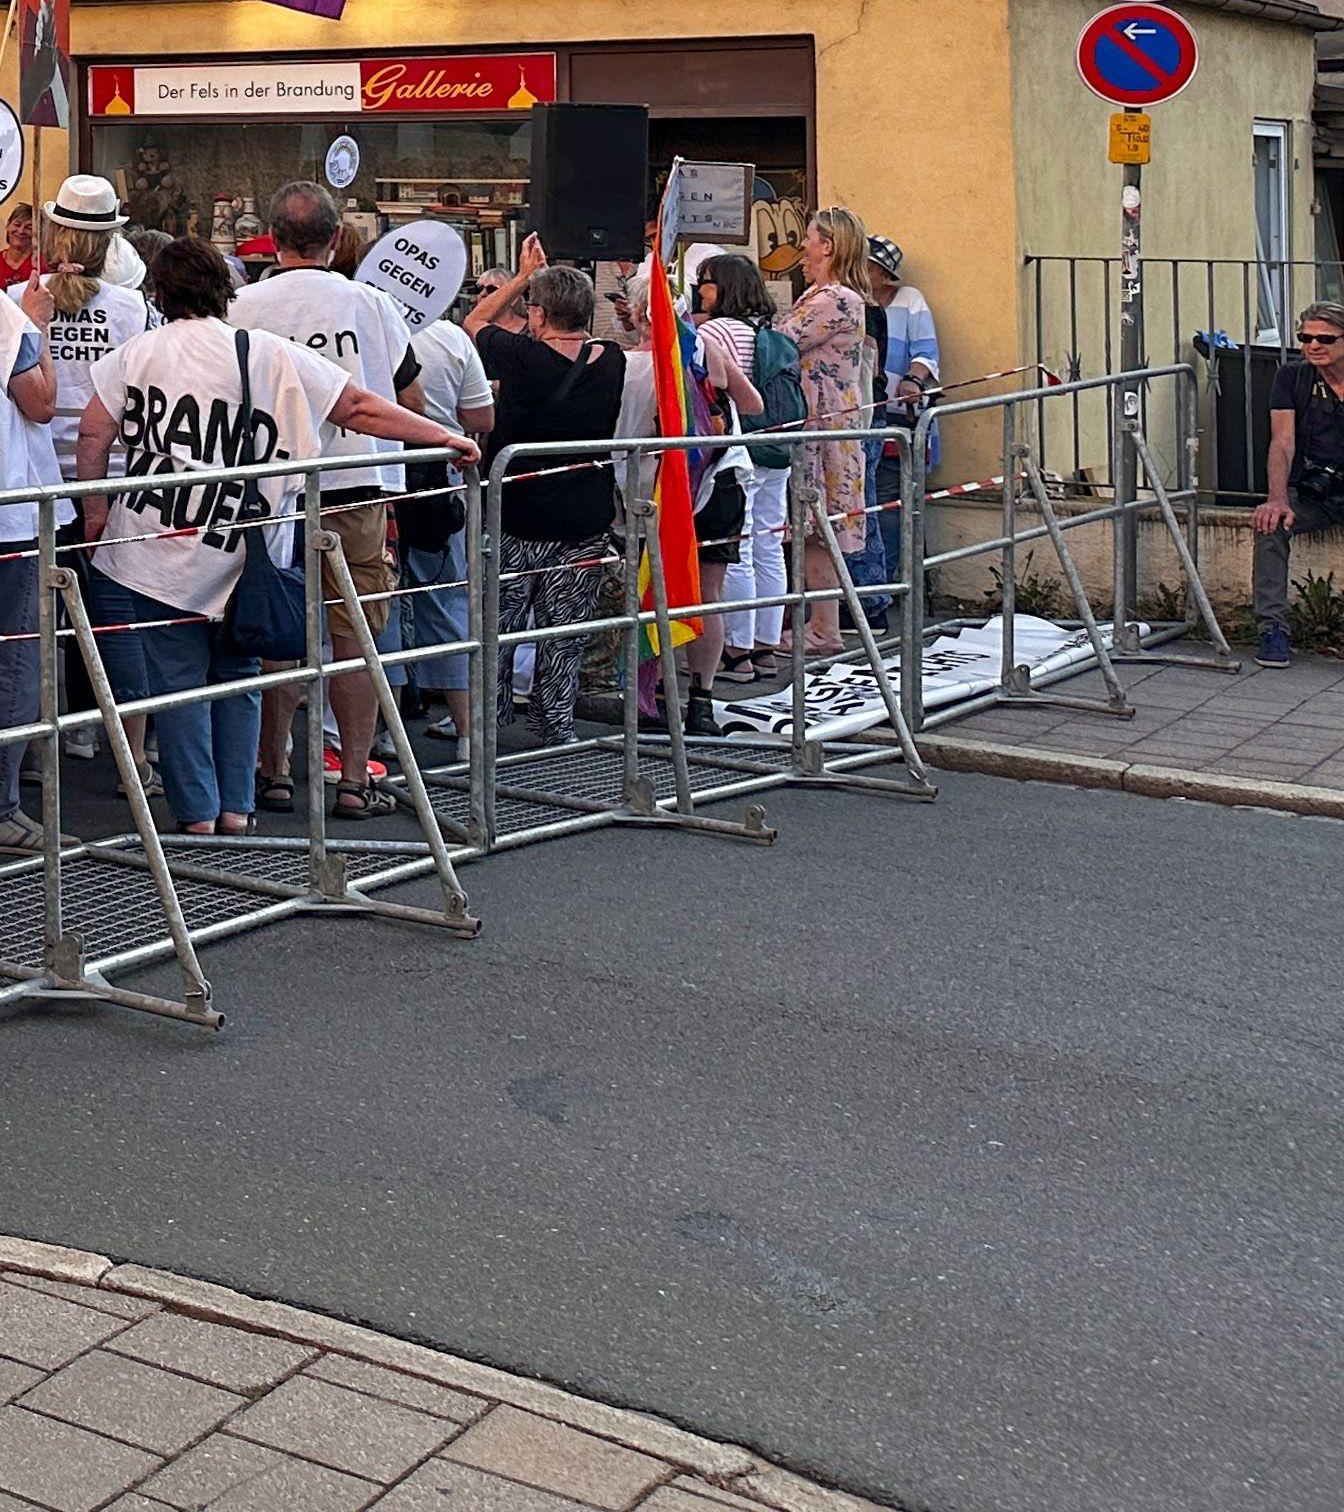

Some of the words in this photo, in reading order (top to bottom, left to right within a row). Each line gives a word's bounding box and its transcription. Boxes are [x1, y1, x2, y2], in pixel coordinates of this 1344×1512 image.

[158, 84, 184, 99] Der
[191, 82, 219, 99] Fels
[224, 83, 238, 98] in
[244, 81, 271, 98] der
[277, 80, 355, 101] Brandung
[362, 64, 494, 109] Gallerie
[394, 237, 440, 270] OPAS
[378, 258, 436, 299] GEGEN
